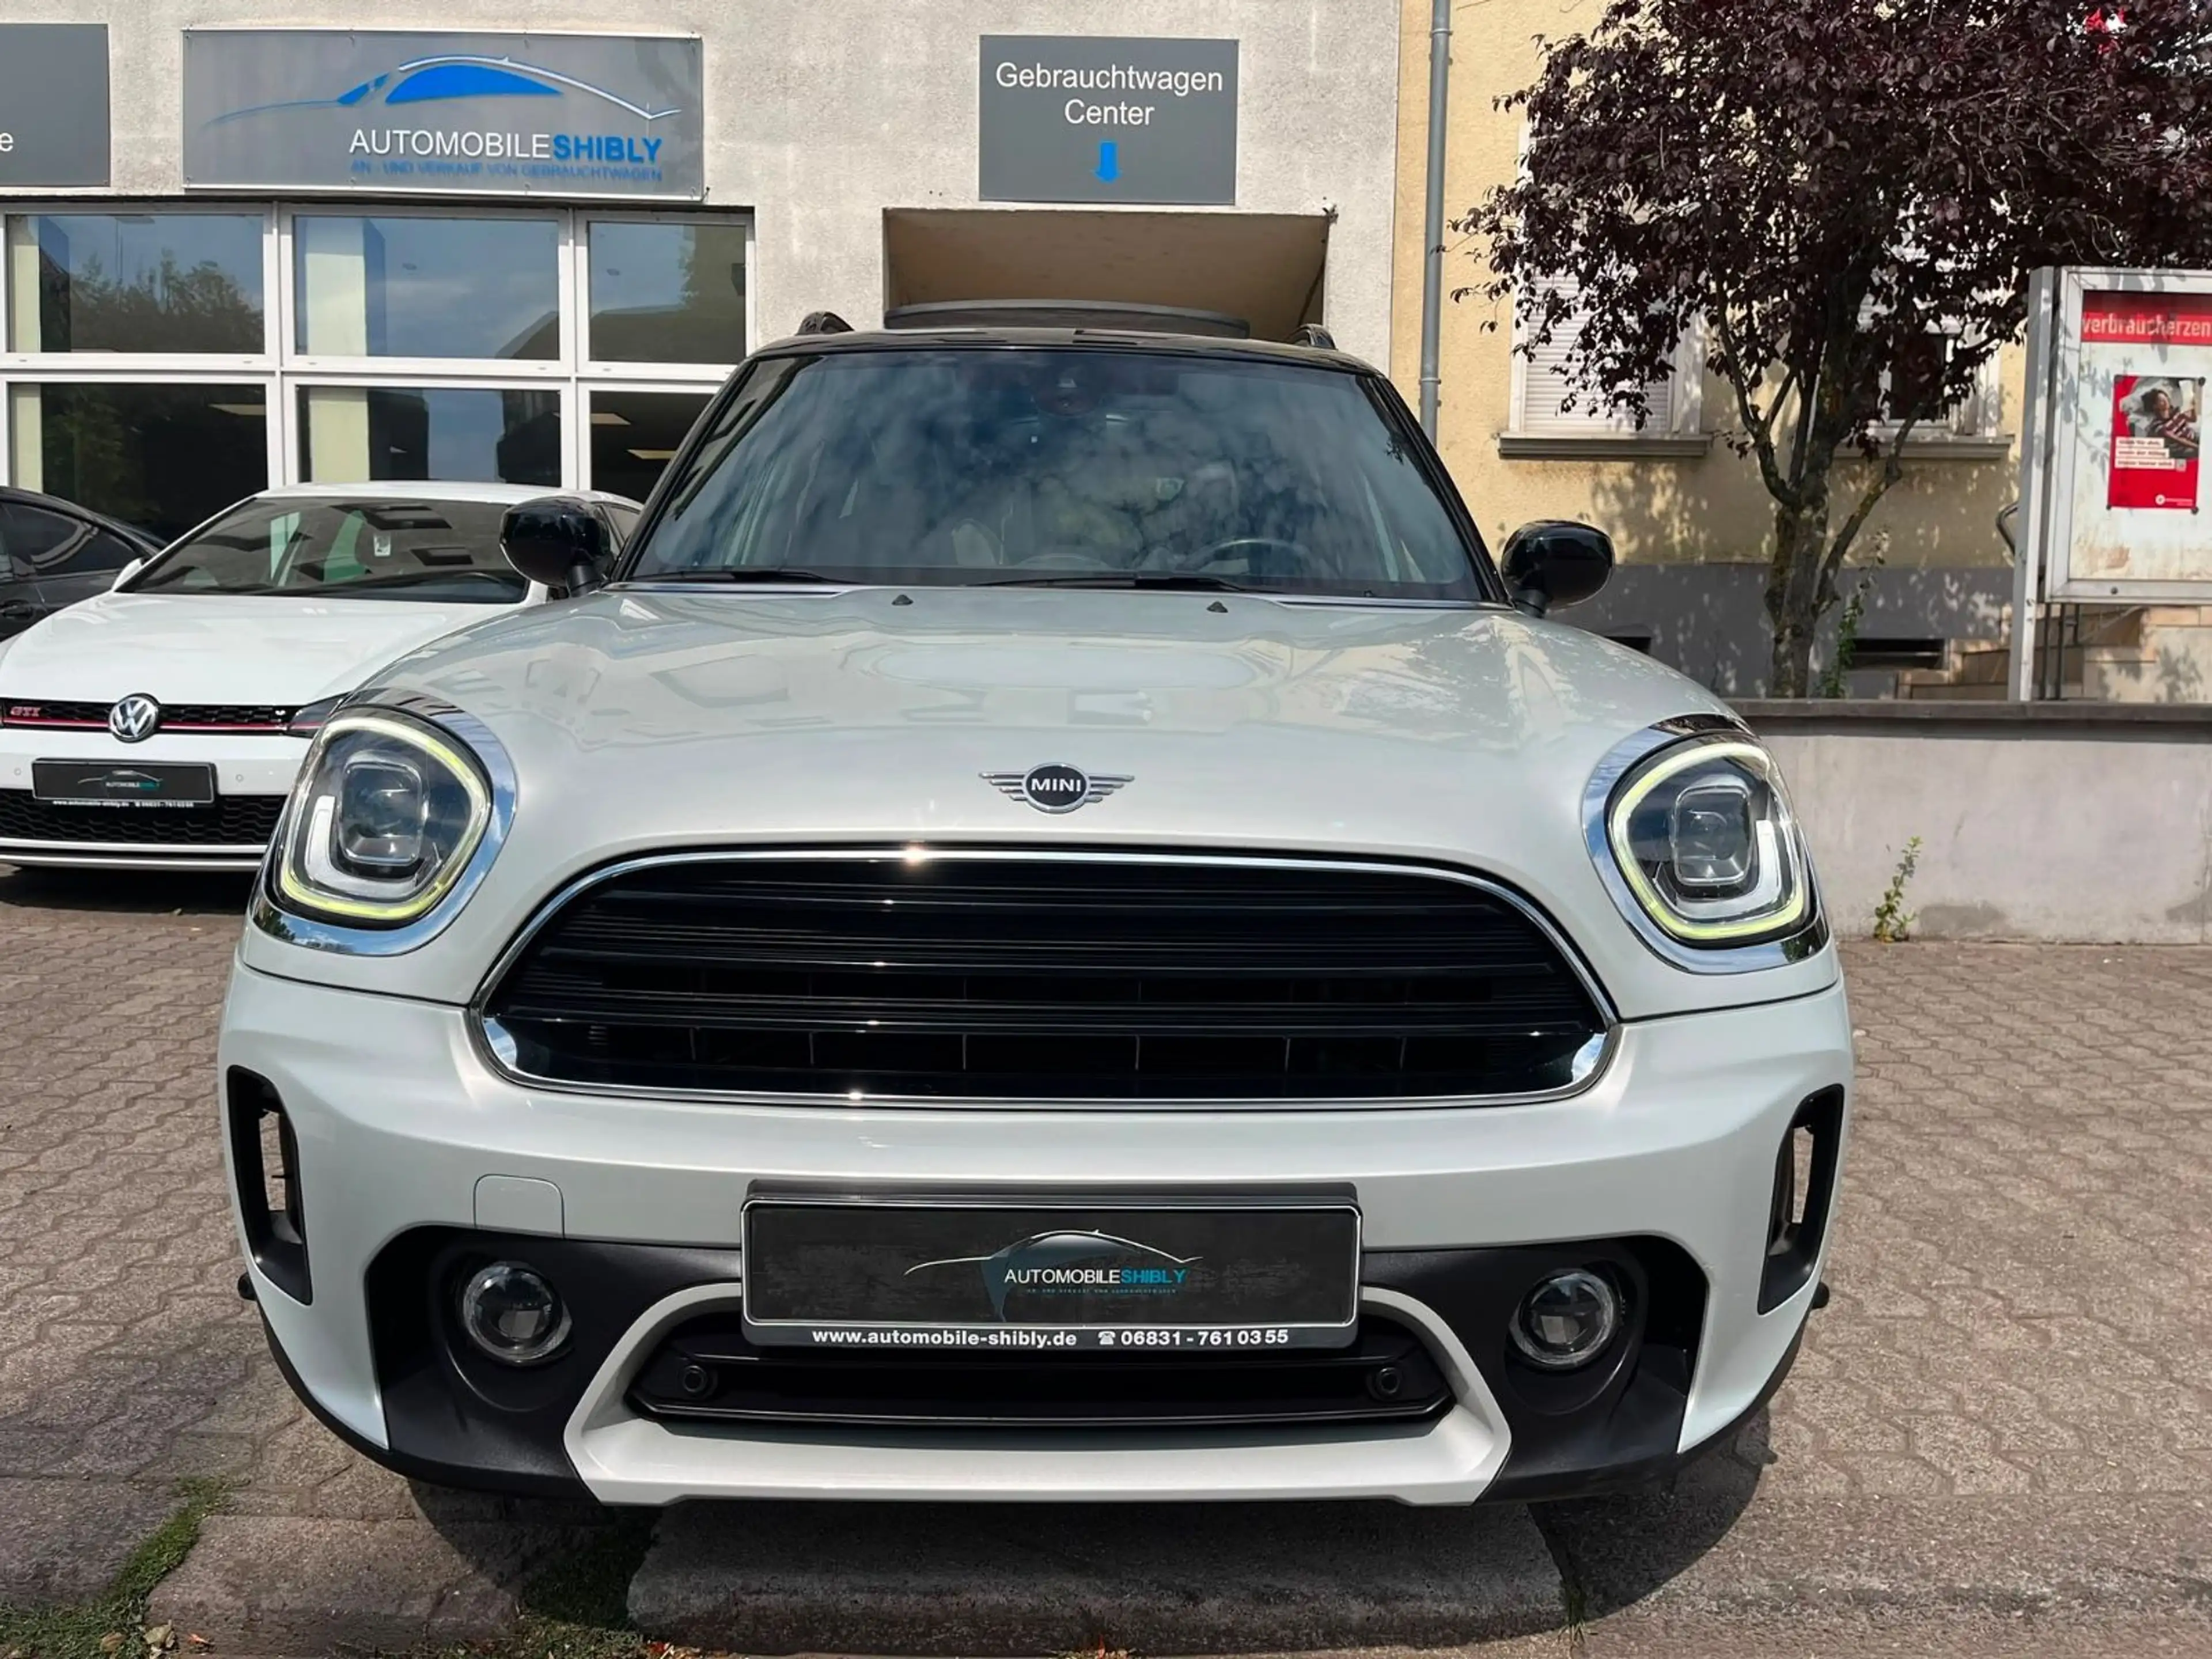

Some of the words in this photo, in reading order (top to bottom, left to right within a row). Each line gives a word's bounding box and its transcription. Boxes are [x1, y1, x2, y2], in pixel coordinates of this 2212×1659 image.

[995, 62, 1223, 97] Gebrauchtwagen
[1064, 99, 1155, 126] Center
[418, 161, 483, 177] VERKAUF
[487, 162, 517, 178] VON
[10, 706, 41, 717] GTI
[1031, 778, 1081, 792] MINI
[812, 1330, 1077, 1349] www.automobile-shibly.de
